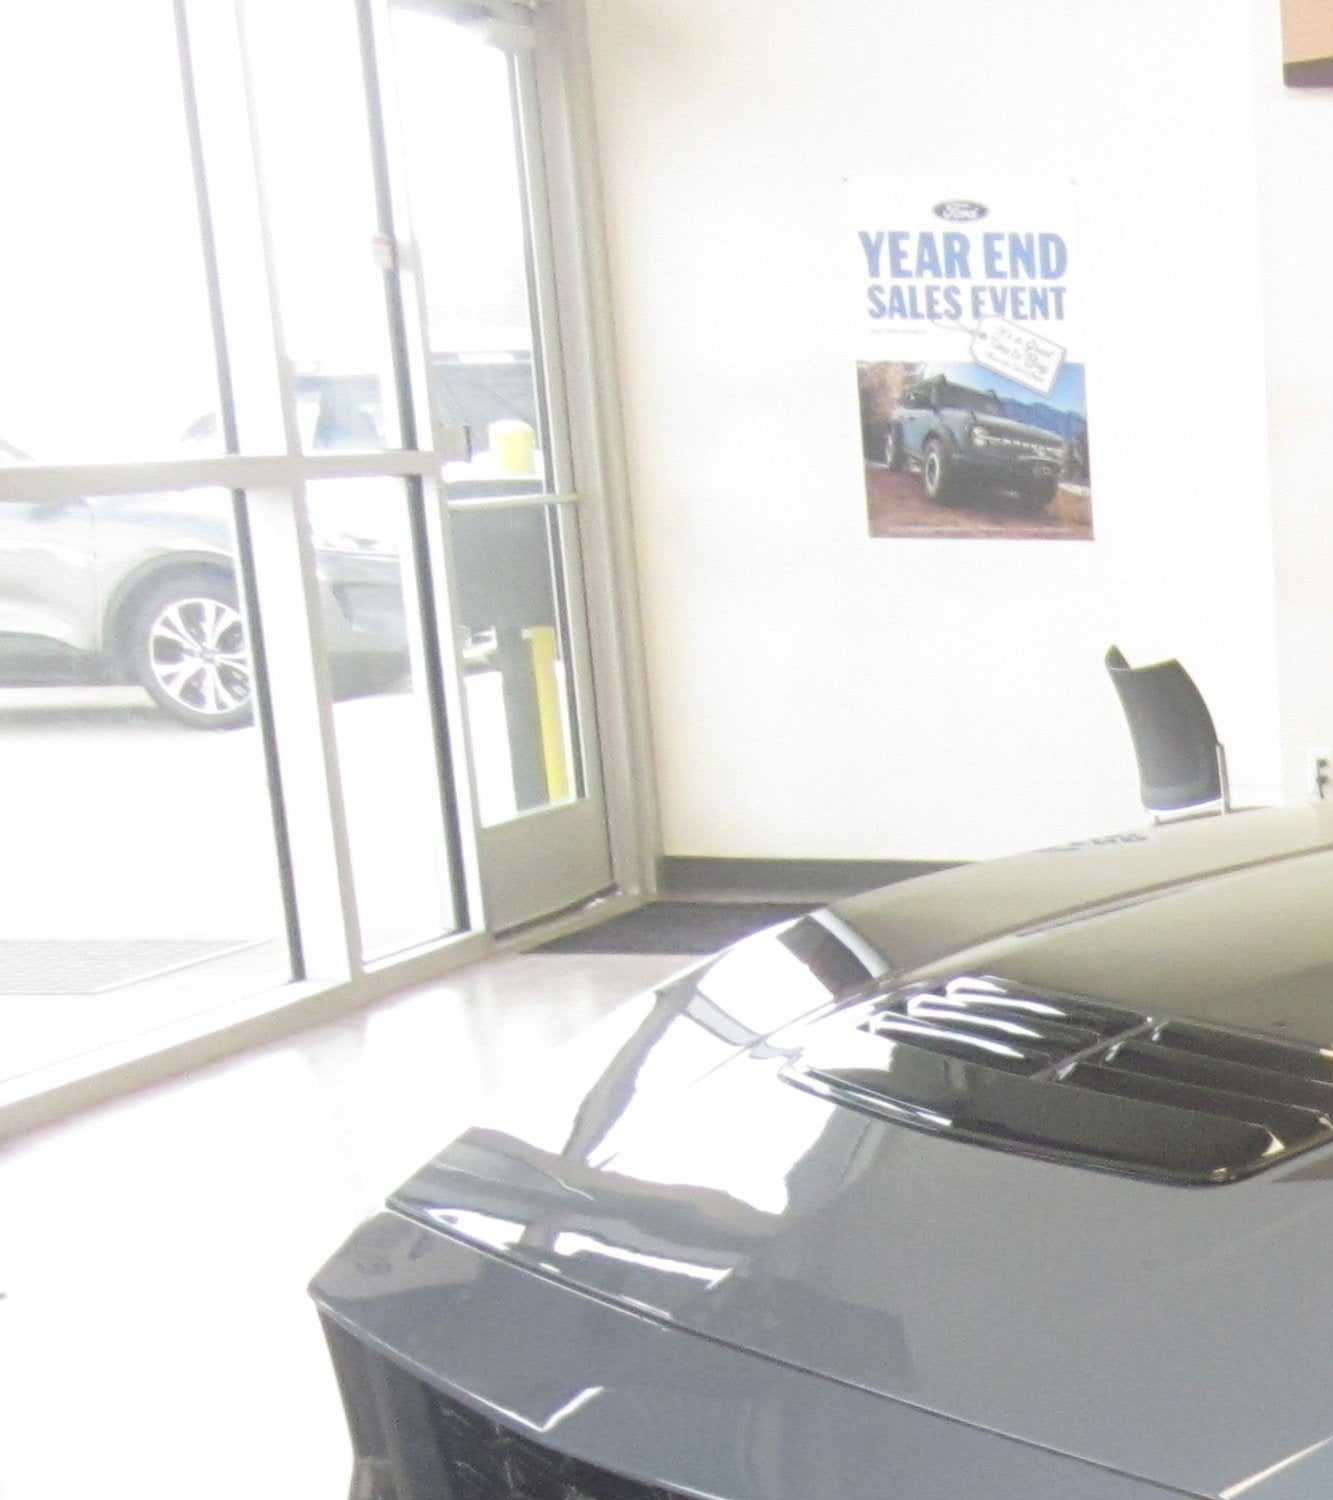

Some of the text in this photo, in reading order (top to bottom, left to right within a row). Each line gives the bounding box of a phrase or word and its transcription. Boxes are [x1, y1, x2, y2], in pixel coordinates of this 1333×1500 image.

[858, 231, 1069, 281] YEAR END
[867, 284, 1067, 321] SALES EVENT
